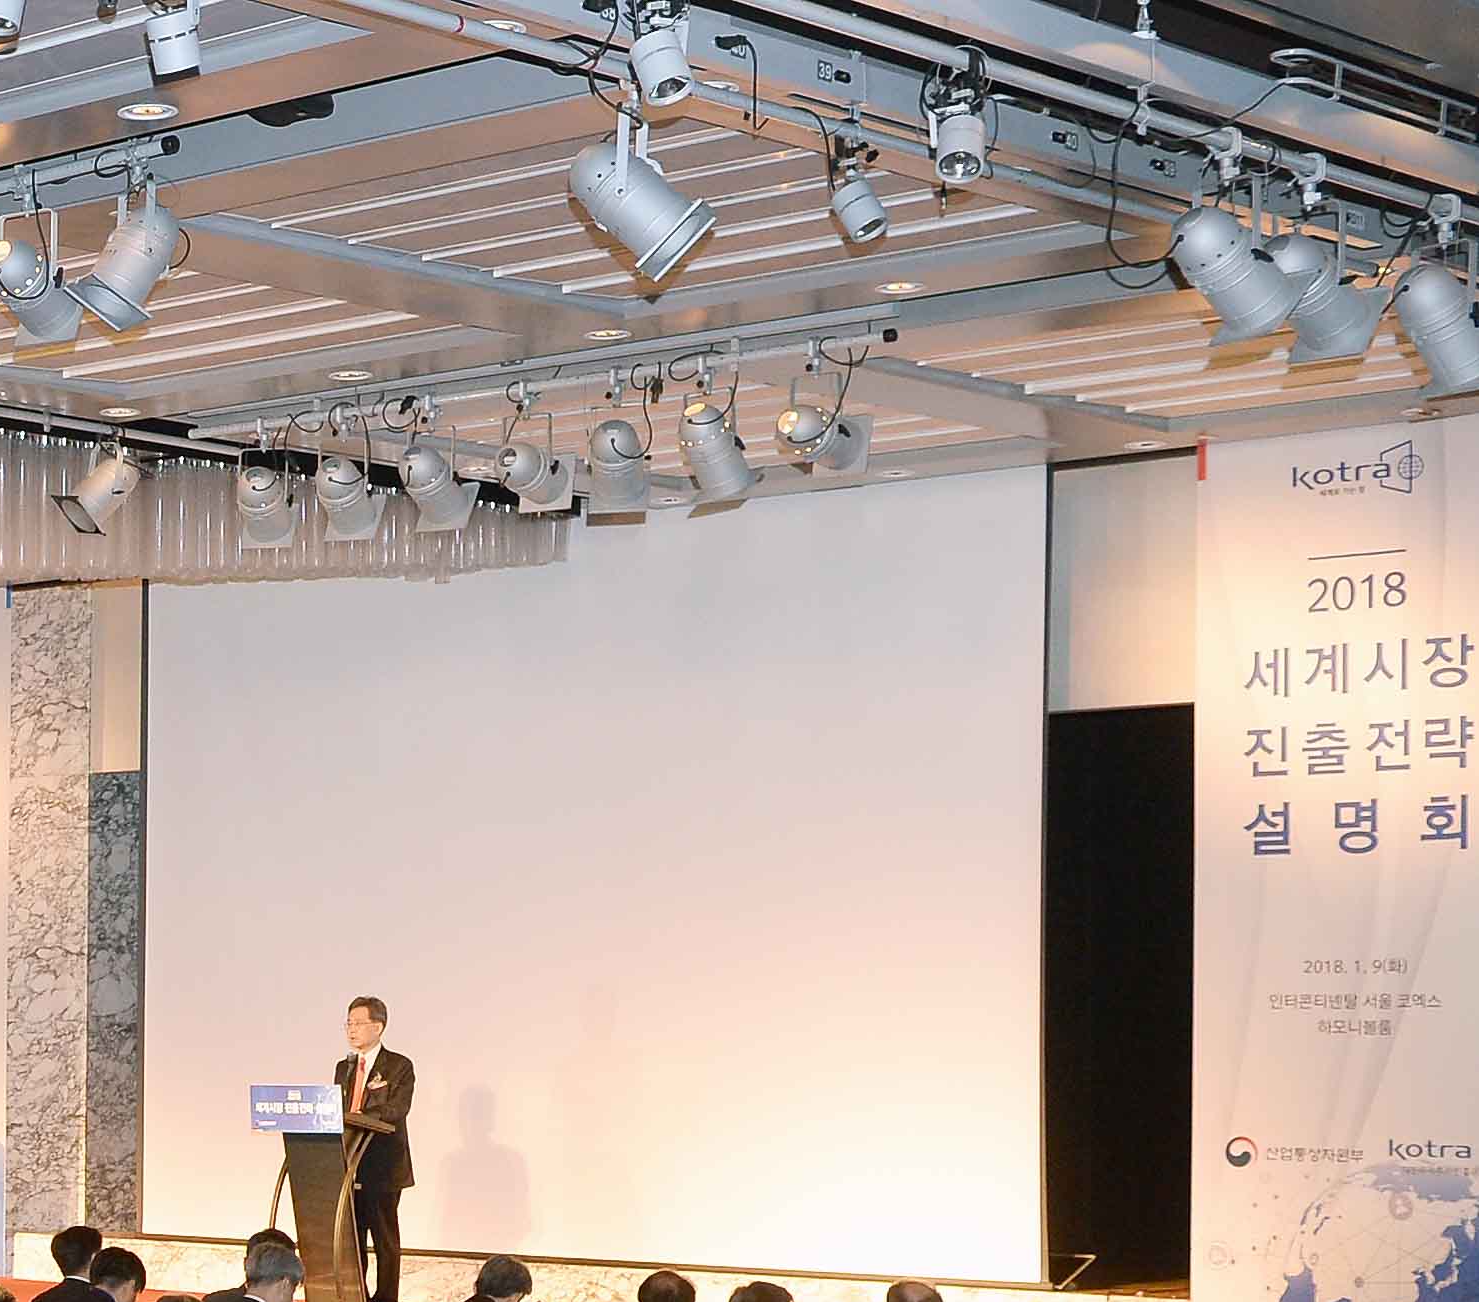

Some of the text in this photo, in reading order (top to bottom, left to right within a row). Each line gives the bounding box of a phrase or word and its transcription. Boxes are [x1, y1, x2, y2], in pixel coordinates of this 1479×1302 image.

[817, 60, 833, 80] 39
[1292, 461, 1391, 491] kotra
[1307, 571, 1407, 613] 2018
[1243, 633, 1475, 698] 세계시장
[1243, 715, 1475, 778] 진출전략
[1302, 959, 1348, 975] 2018.
[1268, 993, 1358, 1010] 인터콘티넨탈
[1363, 993, 1392, 1010] 서울
[1266, 1138, 1472, 1163] 산업통상자원부 kotra
